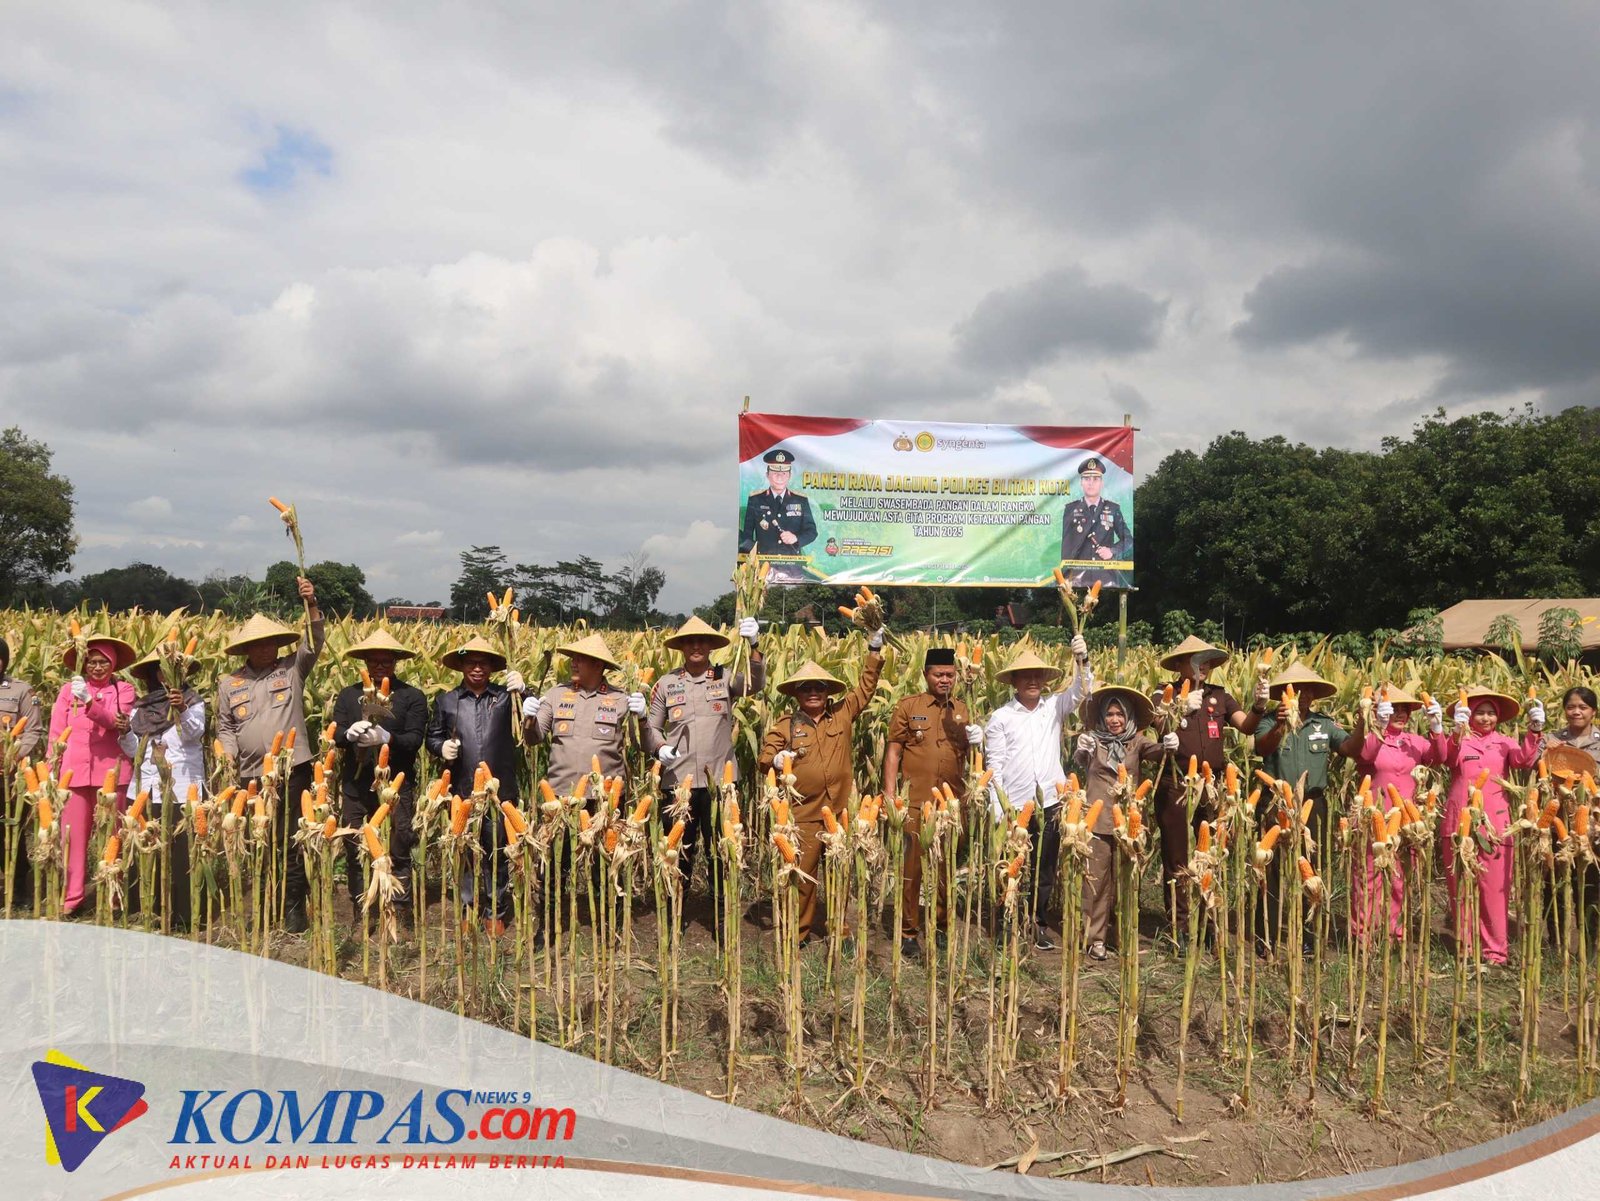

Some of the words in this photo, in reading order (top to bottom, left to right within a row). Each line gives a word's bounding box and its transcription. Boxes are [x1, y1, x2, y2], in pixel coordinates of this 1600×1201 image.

[937, 436, 985, 451] syngenta
[803, 472, 845, 490] PANEN
[848, 472, 882, 492] RAYA
[885, 475, 938, 493] JAGUNG
[941, 477, 989, 495] POLRES
[992, 479, 1036, 495] BLITAR
[1039, 479, 1070, 496] KOTA
[840, 497, 876, 508] MELALUI
[878, 498, 933, 510] SWASEMBADA
[935, 500, 968, 511] PANGAN
[971, 501, 999, 512] DALAM
[1001, 501, 1035, 512] RANGKA
[824, 510, 880, 521] MEWUJUDKAN
[882, 512, 903, 523] ASTA
[905, 512, 923, 523] CITA
[926, 513, 966, 524] PROGRAM
[968, 514, 1017, 525] KETAHANAN
[1019, 515, 1050, 525] PANGAN
[913, 525, 940, 537] TAHUN
[942, 526, 963, 537] 2025
